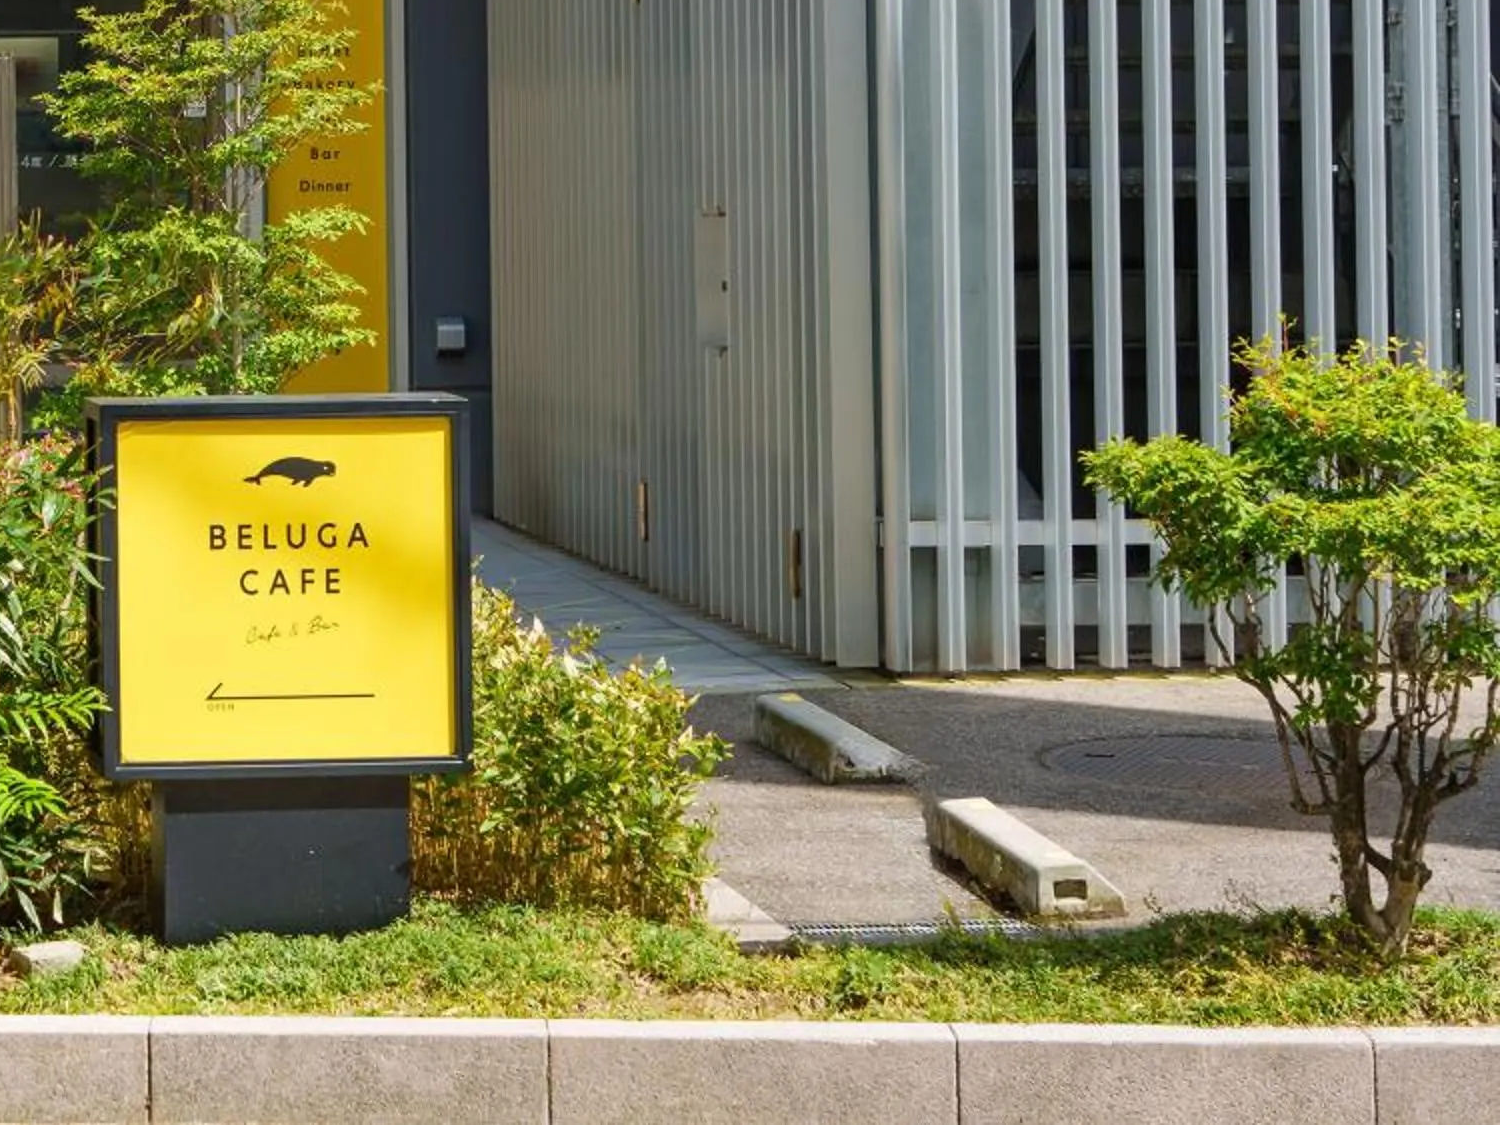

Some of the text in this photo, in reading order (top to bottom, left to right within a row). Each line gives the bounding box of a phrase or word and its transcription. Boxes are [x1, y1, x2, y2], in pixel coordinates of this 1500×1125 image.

[310, 147, 341, 161] Bar
[299, 179, 352, 193] Dinner
[209, 522, 369, 550] BELUGA
[239, 568, 341, 596] CAFE
[246, 625, 281, 644] Cafe
[307, 615, 340, 634] Bar
[206, 702, 235, 712] OPEN
